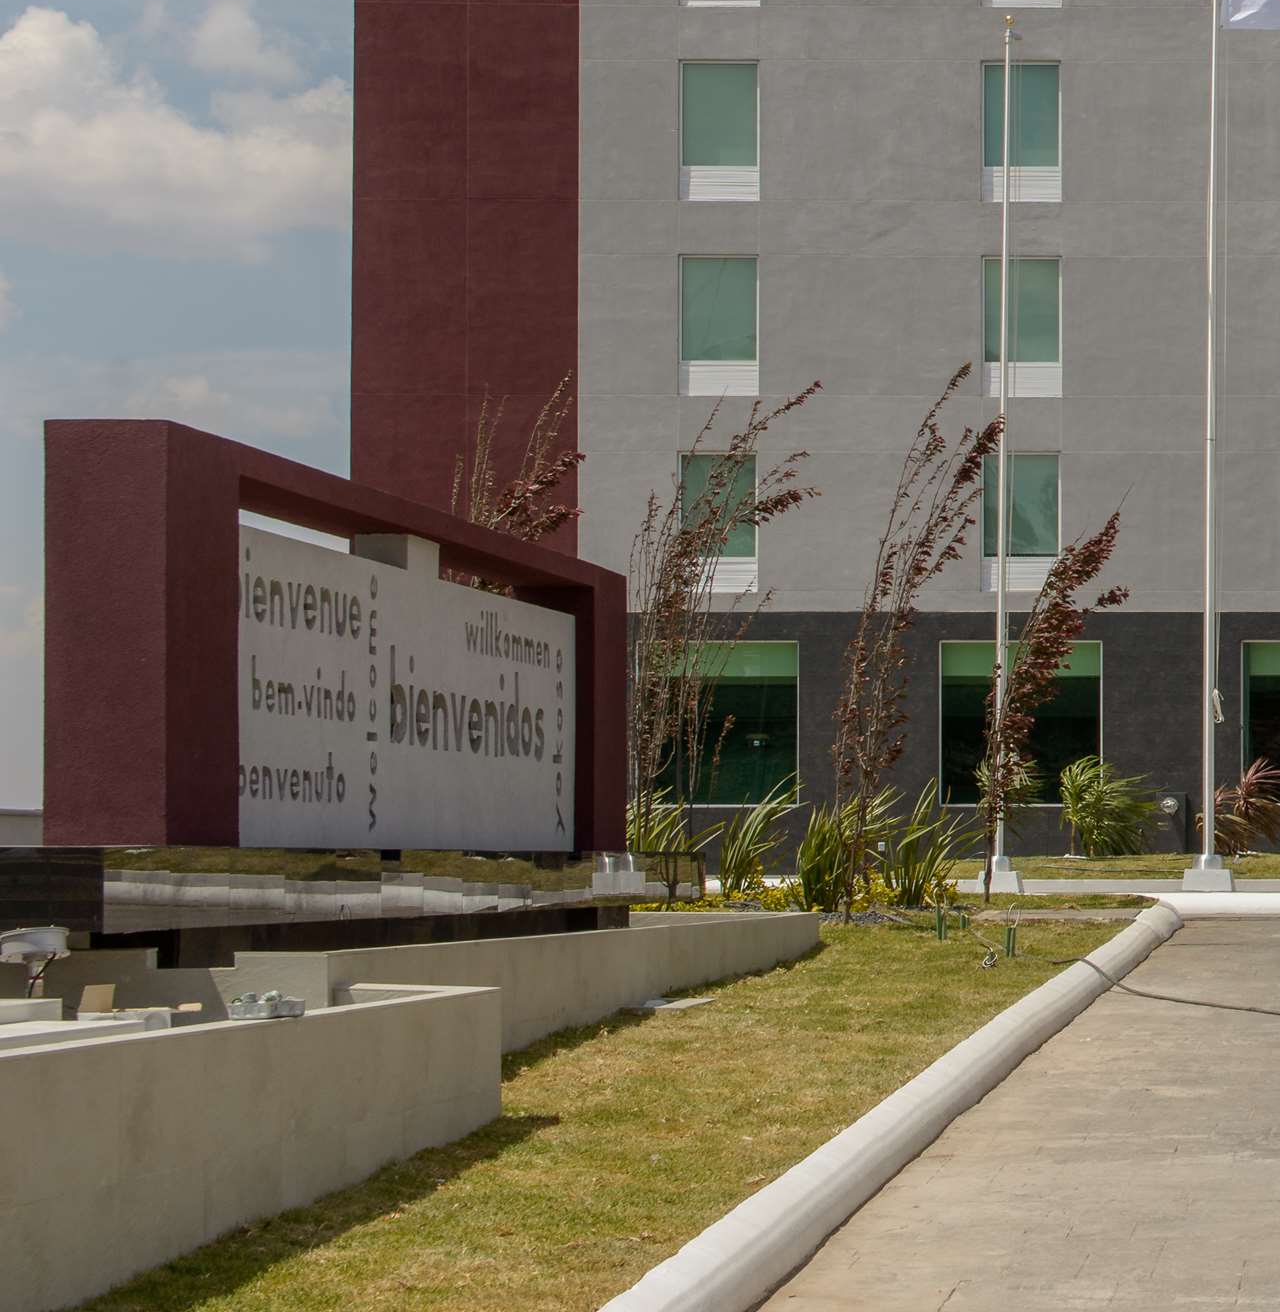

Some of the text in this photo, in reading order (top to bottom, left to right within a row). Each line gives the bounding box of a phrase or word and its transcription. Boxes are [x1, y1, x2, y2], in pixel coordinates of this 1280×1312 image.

[239, 546, 362, 640] ienvenue
[465, 610, 551, 669] willkommen
[366, 574, 378, 833] welcome
[389, 645, 545, 762] bienvenidos
[552, 648, 565, 837] yokoso
